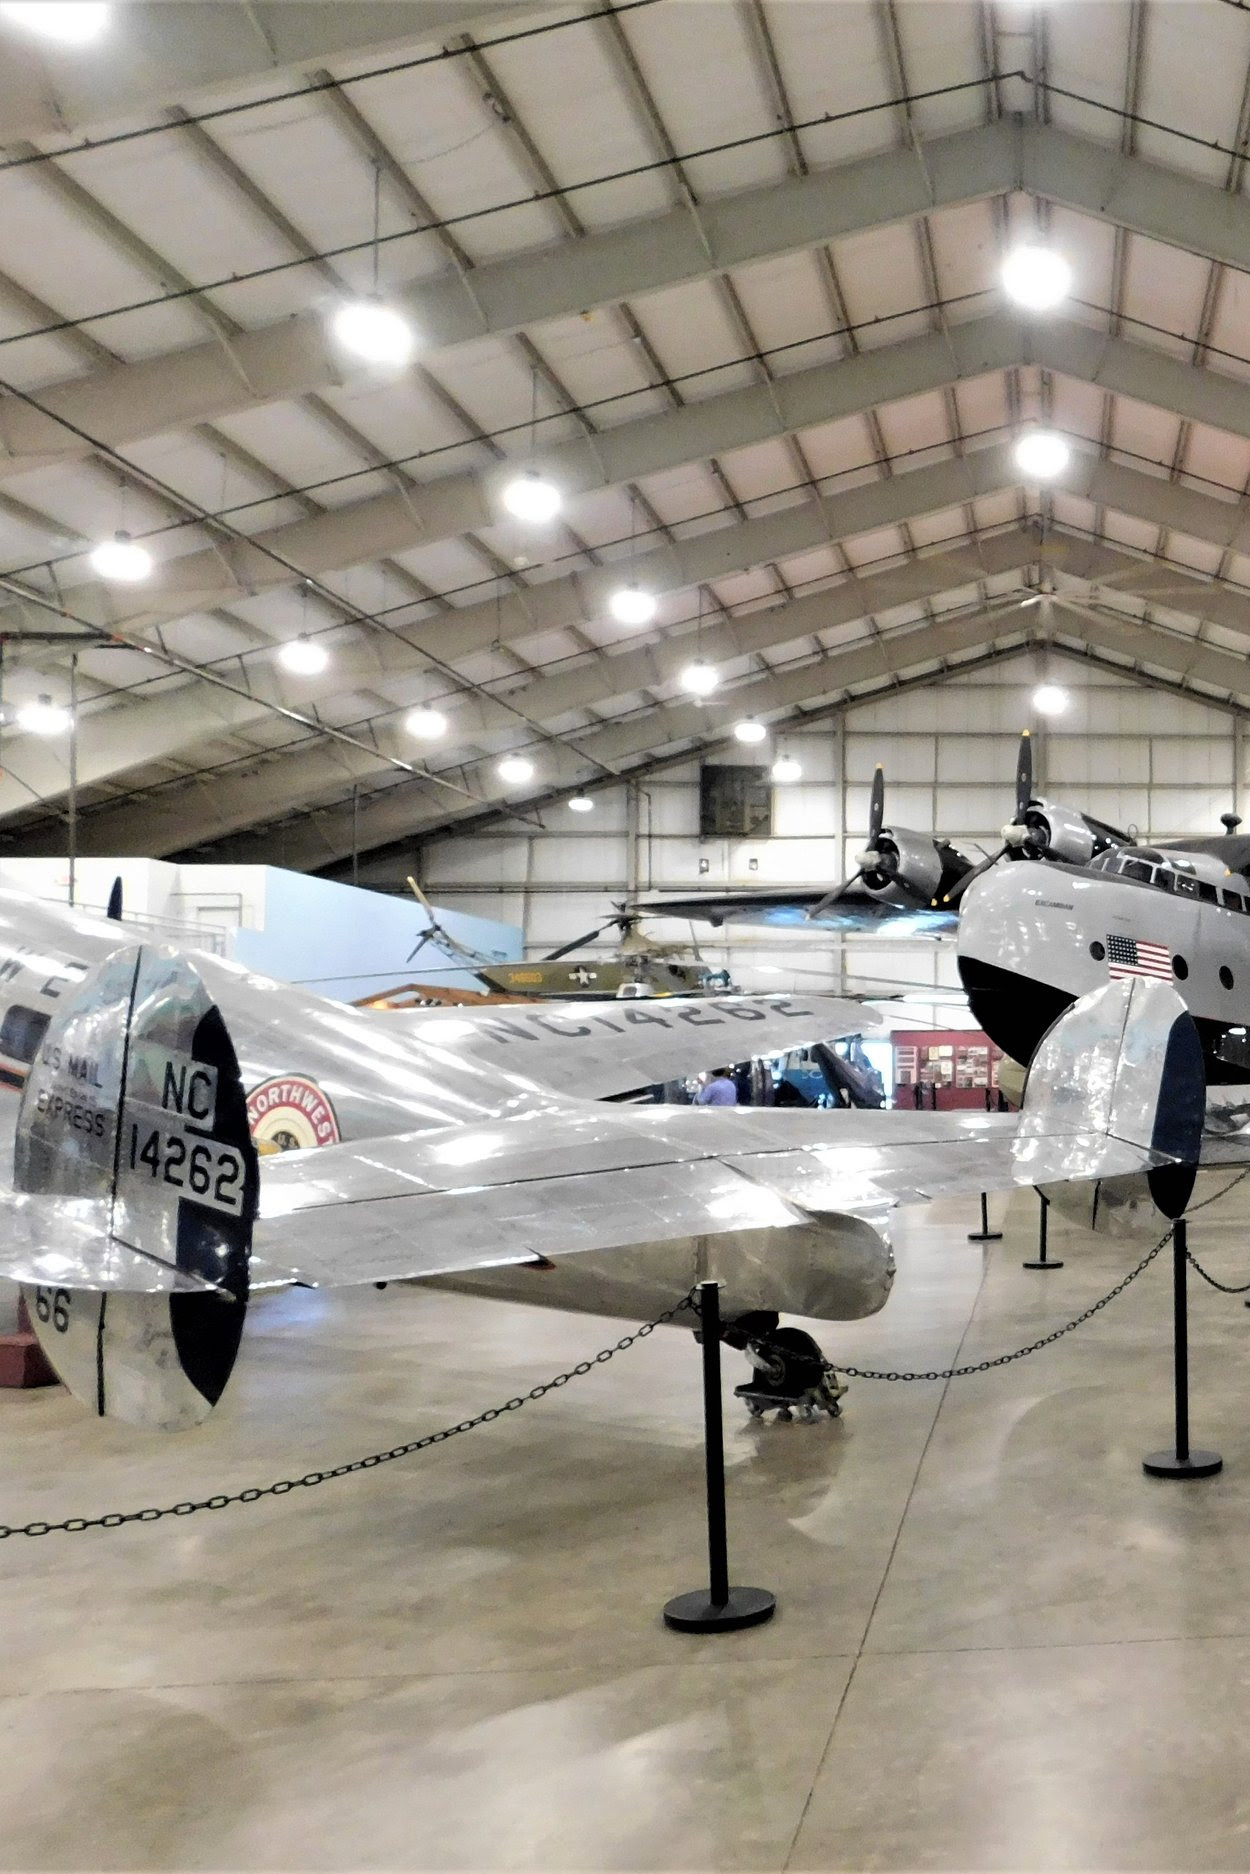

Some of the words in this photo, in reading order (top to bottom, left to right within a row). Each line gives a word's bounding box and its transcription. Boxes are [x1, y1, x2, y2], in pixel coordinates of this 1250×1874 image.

[476, 999, 814, 1044] NC14262
[68, 1054, 104, 1089] MAIL
[162, 1061, 212, 1120] NC
[37, 1088, 106, 1137] EXPRESS
[247, 1084, 335, 1146] NORTHWEST
[129, 1123, 240, 1206] 14262
